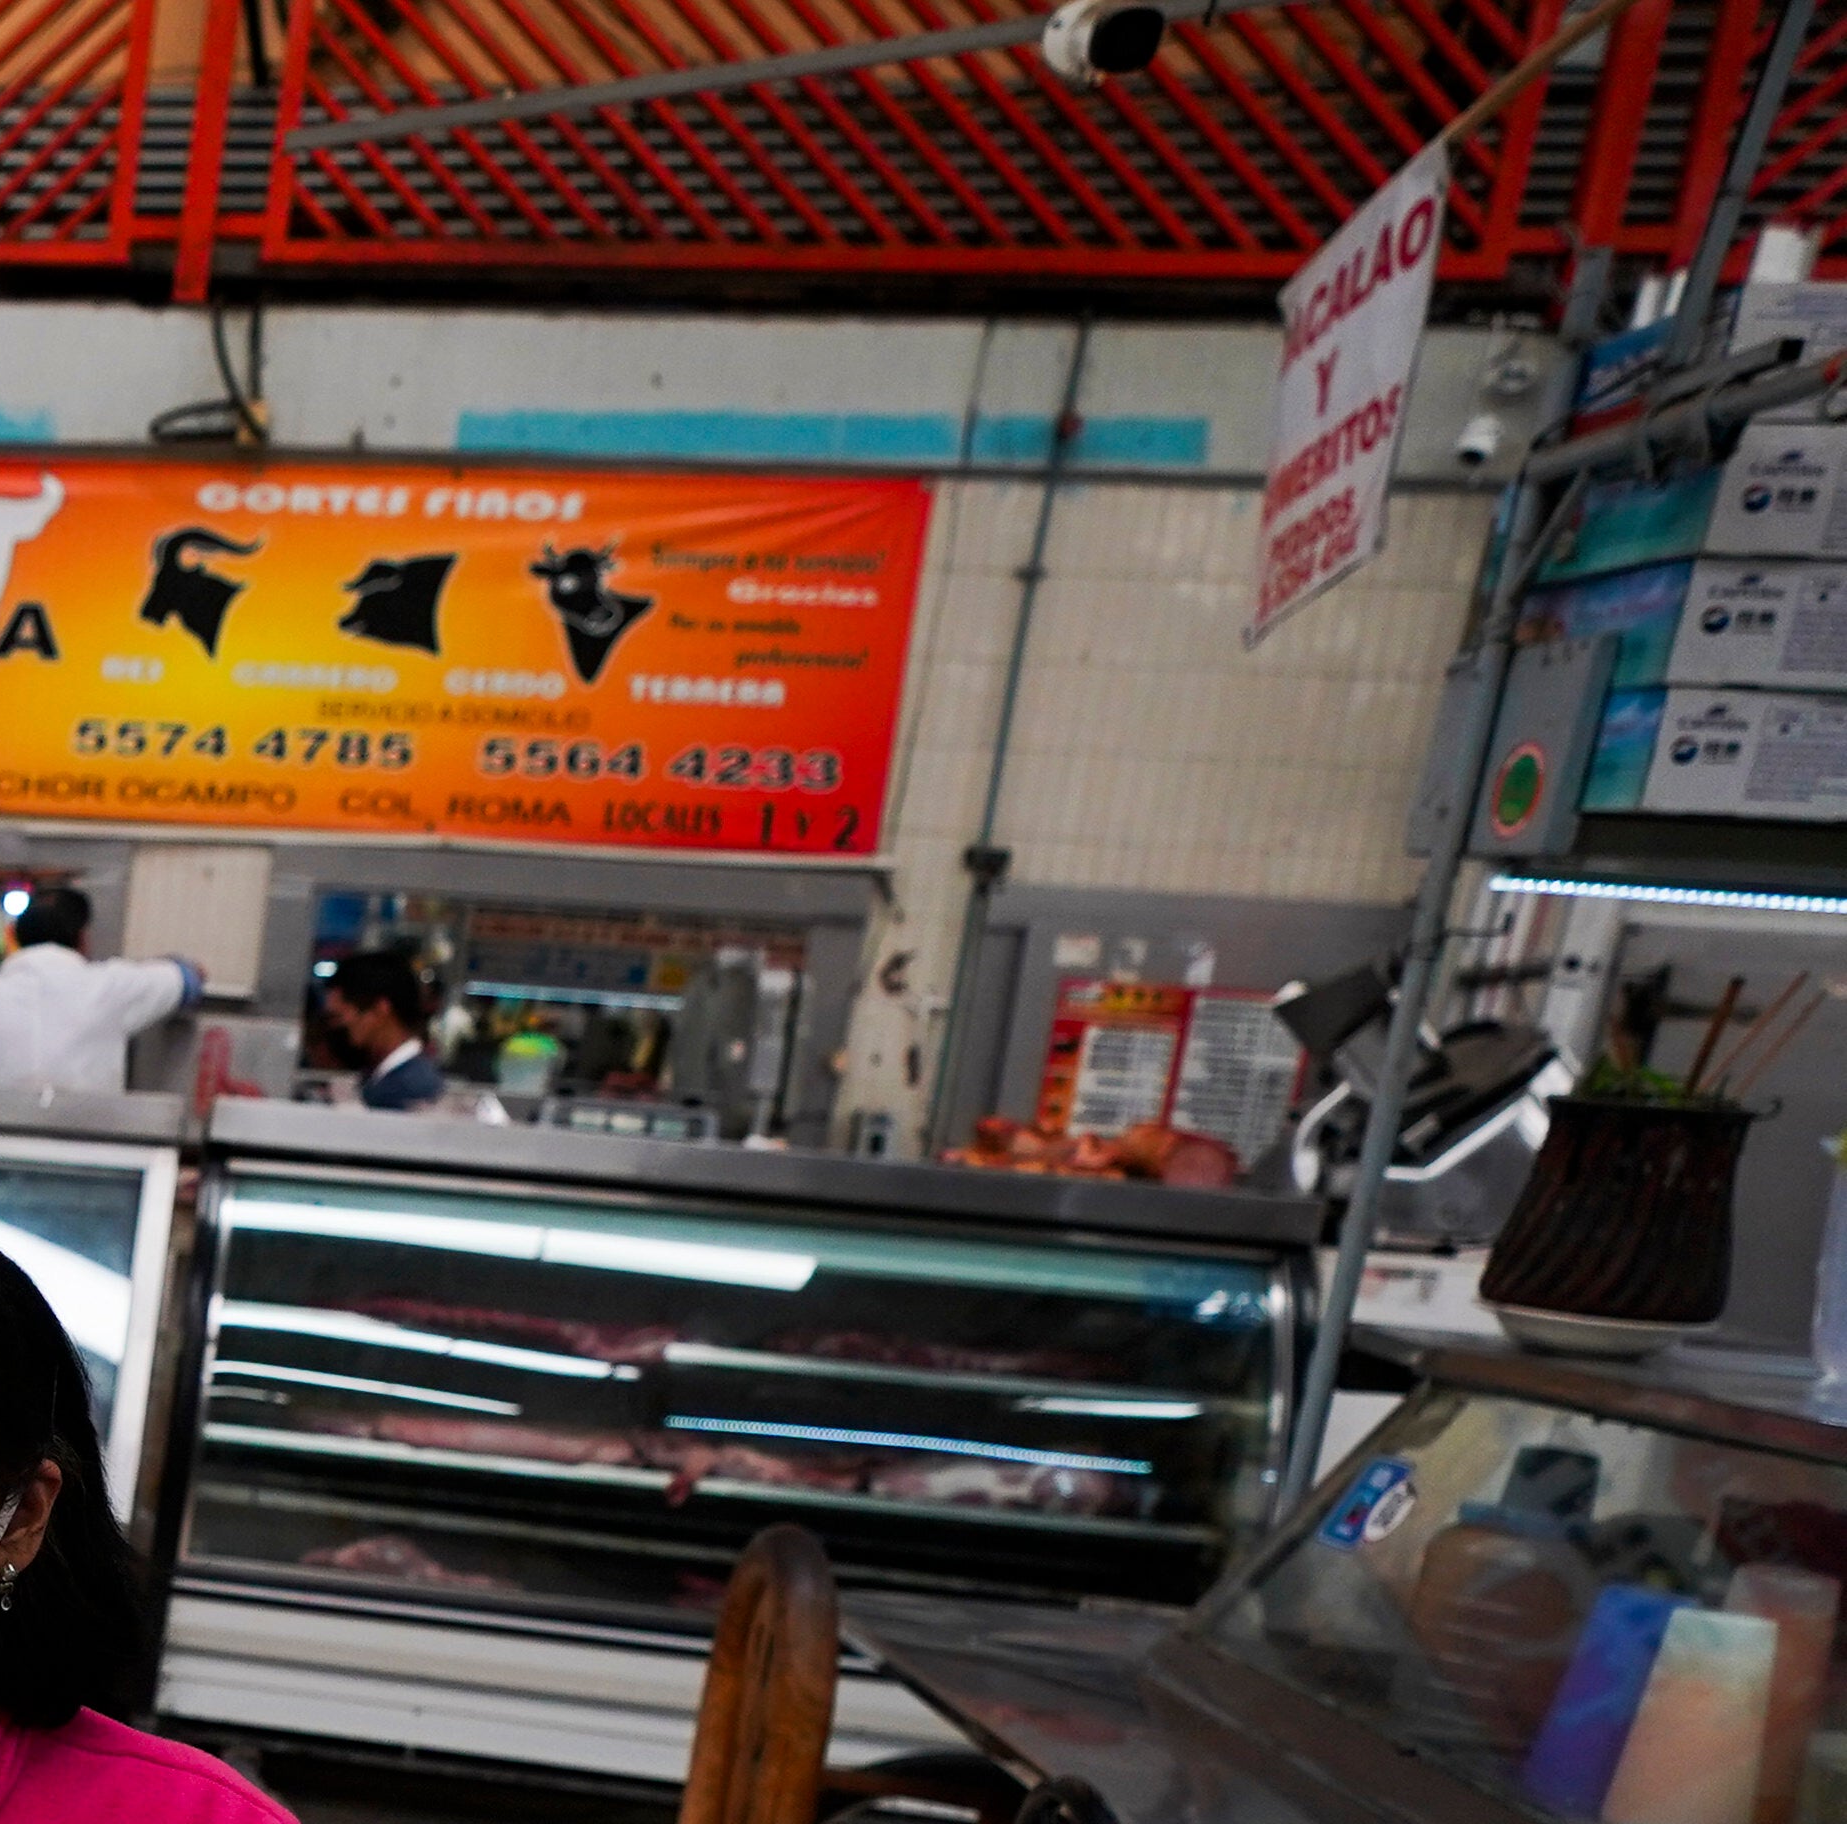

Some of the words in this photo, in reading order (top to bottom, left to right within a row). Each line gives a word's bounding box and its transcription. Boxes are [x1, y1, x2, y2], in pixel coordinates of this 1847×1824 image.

[1315, 346, 1341, 417] Y
[195, 481, 411, 515] CORTES
[423, 487, 587, 523] FINOS
[727, 576, 879, 609] Gracias
[74, 717, 228, 760] 5574
[252, 726, 414, 770] 4785
[481, 737, 645, 781] 5564
[667, 746, 843, 792] 4233
[118, 774, 298, 814] OCAMPO
[445, 793, 573, 828] ROMA
[601, 796, 723, 838] LOCALES
[760, 802, 775, 846] 1
[833, 804, 860, 851] 2
